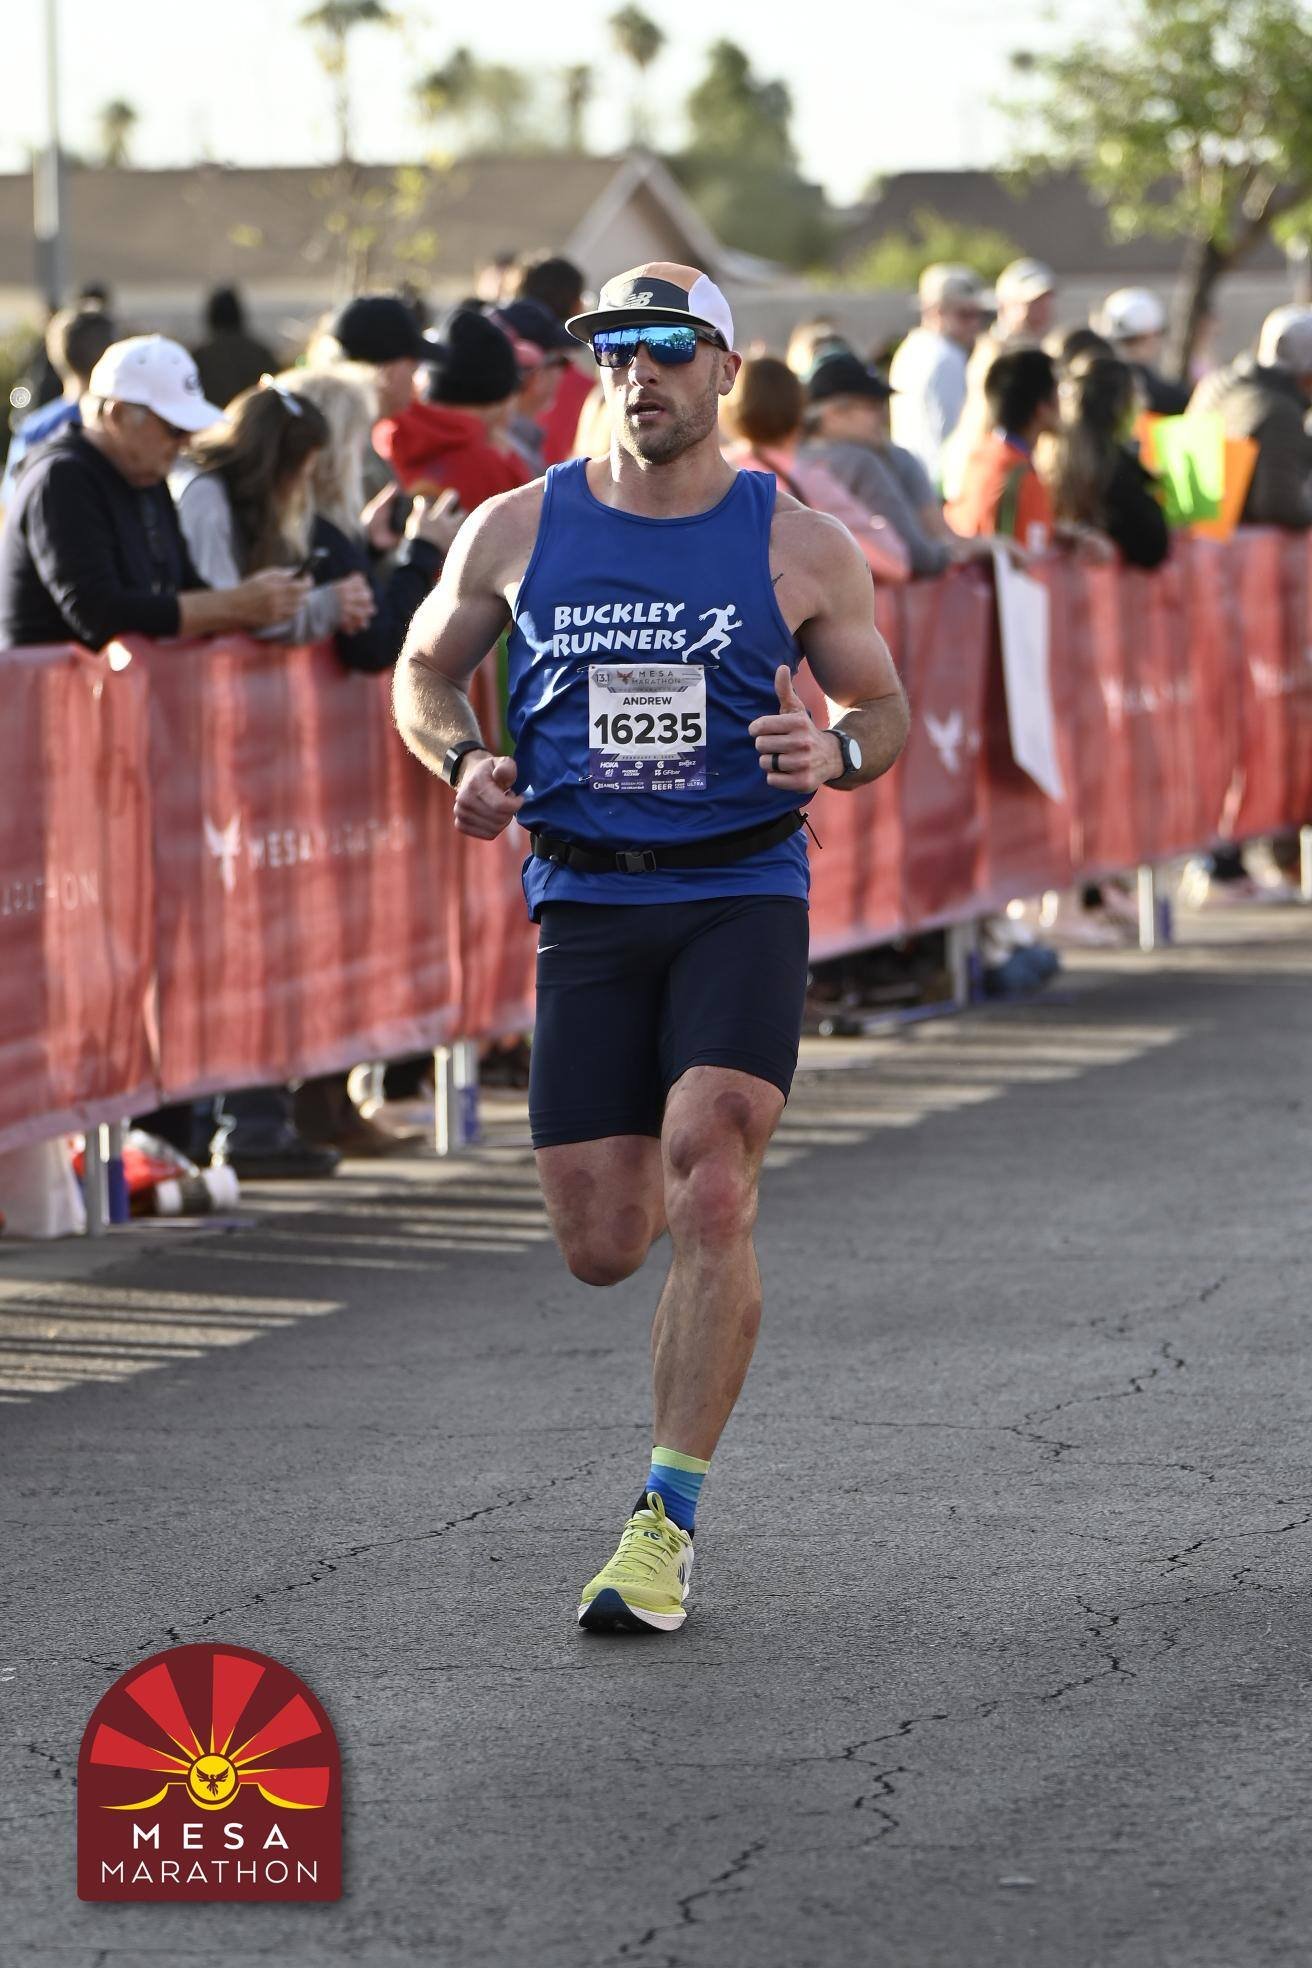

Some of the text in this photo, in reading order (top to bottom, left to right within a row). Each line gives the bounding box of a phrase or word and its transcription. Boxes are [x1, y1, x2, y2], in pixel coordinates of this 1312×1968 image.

[554, 602, 685, 631] BUCKLEY
[552, 628, 687, 658] RUNNERS
[595, 673, 610, 682] 13.1
[631, 677, 681, 685] MARATHON
[622, 696, 673, 706] ANDREW
[594, 712, 702, 745] 16235
[651, 783, 673, 791] BEER
